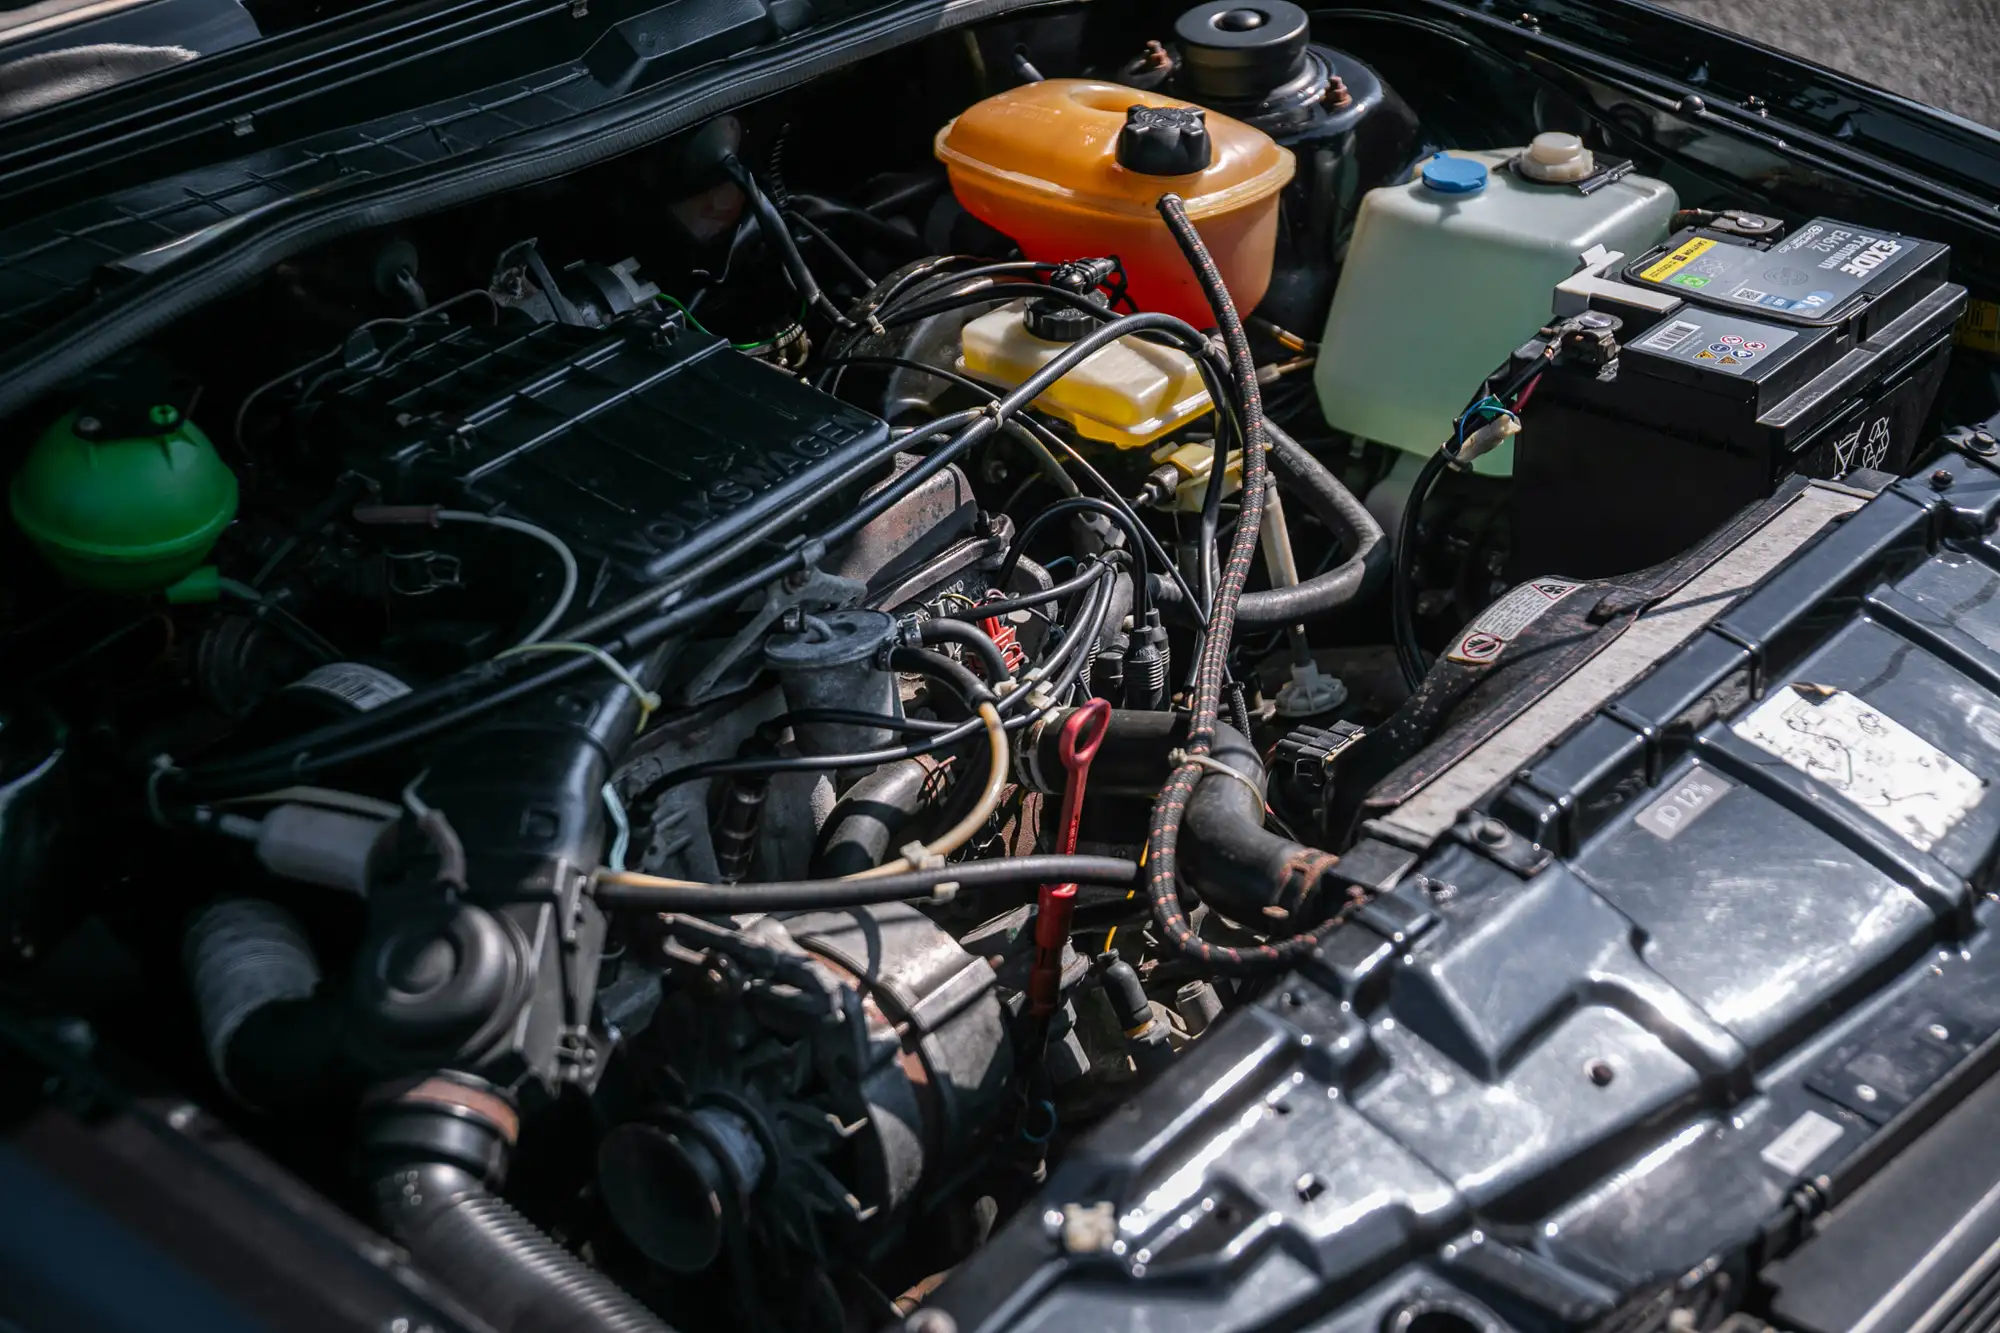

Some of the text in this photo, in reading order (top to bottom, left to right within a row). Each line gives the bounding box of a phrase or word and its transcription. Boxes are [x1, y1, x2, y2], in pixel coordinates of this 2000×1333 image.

[1814, 229, 1852, 253] EA612
[1817, 235, 1877, 270] Premium
[1839, 239, 1903, 279] EXIDE
[1802, 294, 1826, 308] 61
[612, 413, 880, 555] VOLKSWAGEN
